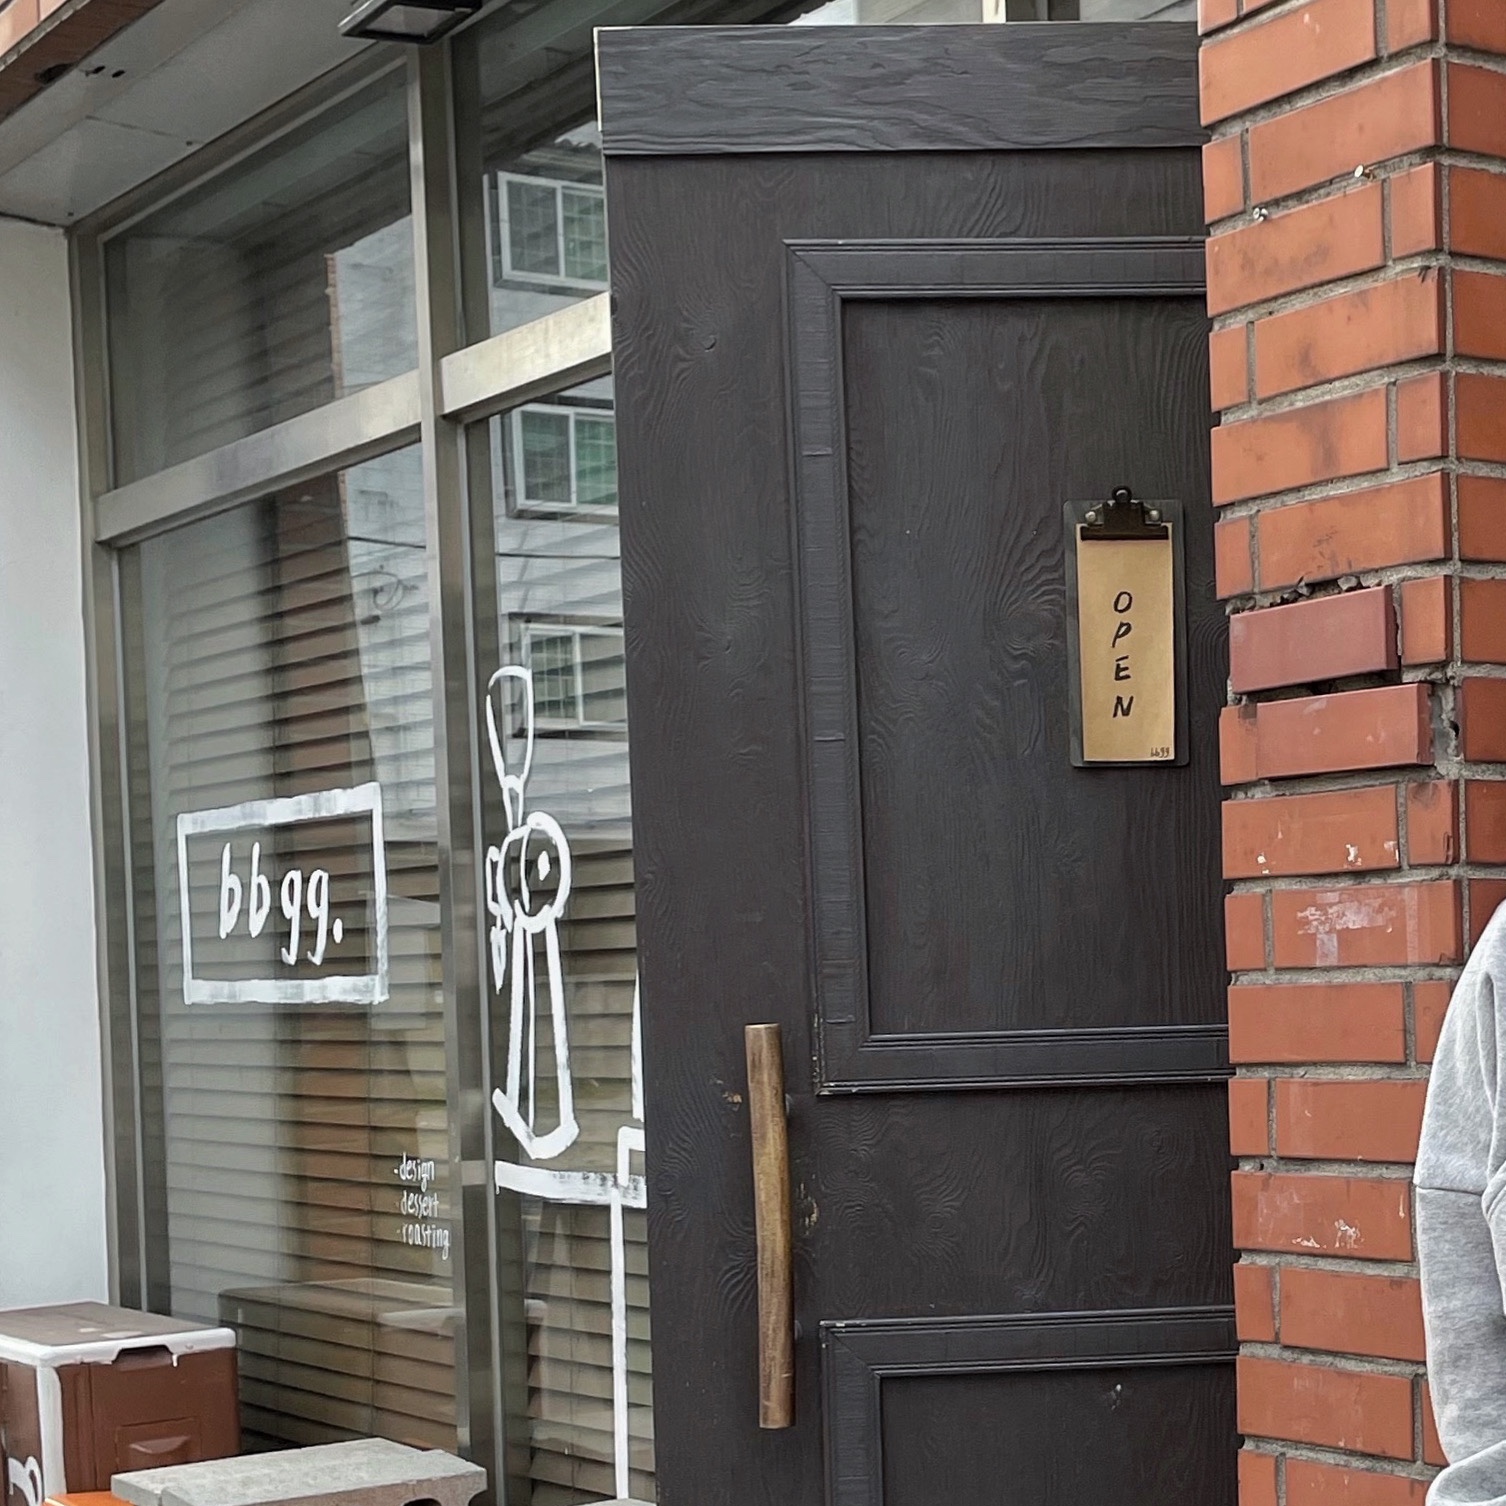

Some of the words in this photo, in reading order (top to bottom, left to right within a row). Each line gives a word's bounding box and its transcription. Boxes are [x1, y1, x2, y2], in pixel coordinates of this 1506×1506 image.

[1112, 591, 1133, 718] OPEN
[400, 1152, 435, 1193] design
[401, 1190, 440, 1220] dessert
[402, 1222, 450, 1261] roasting
